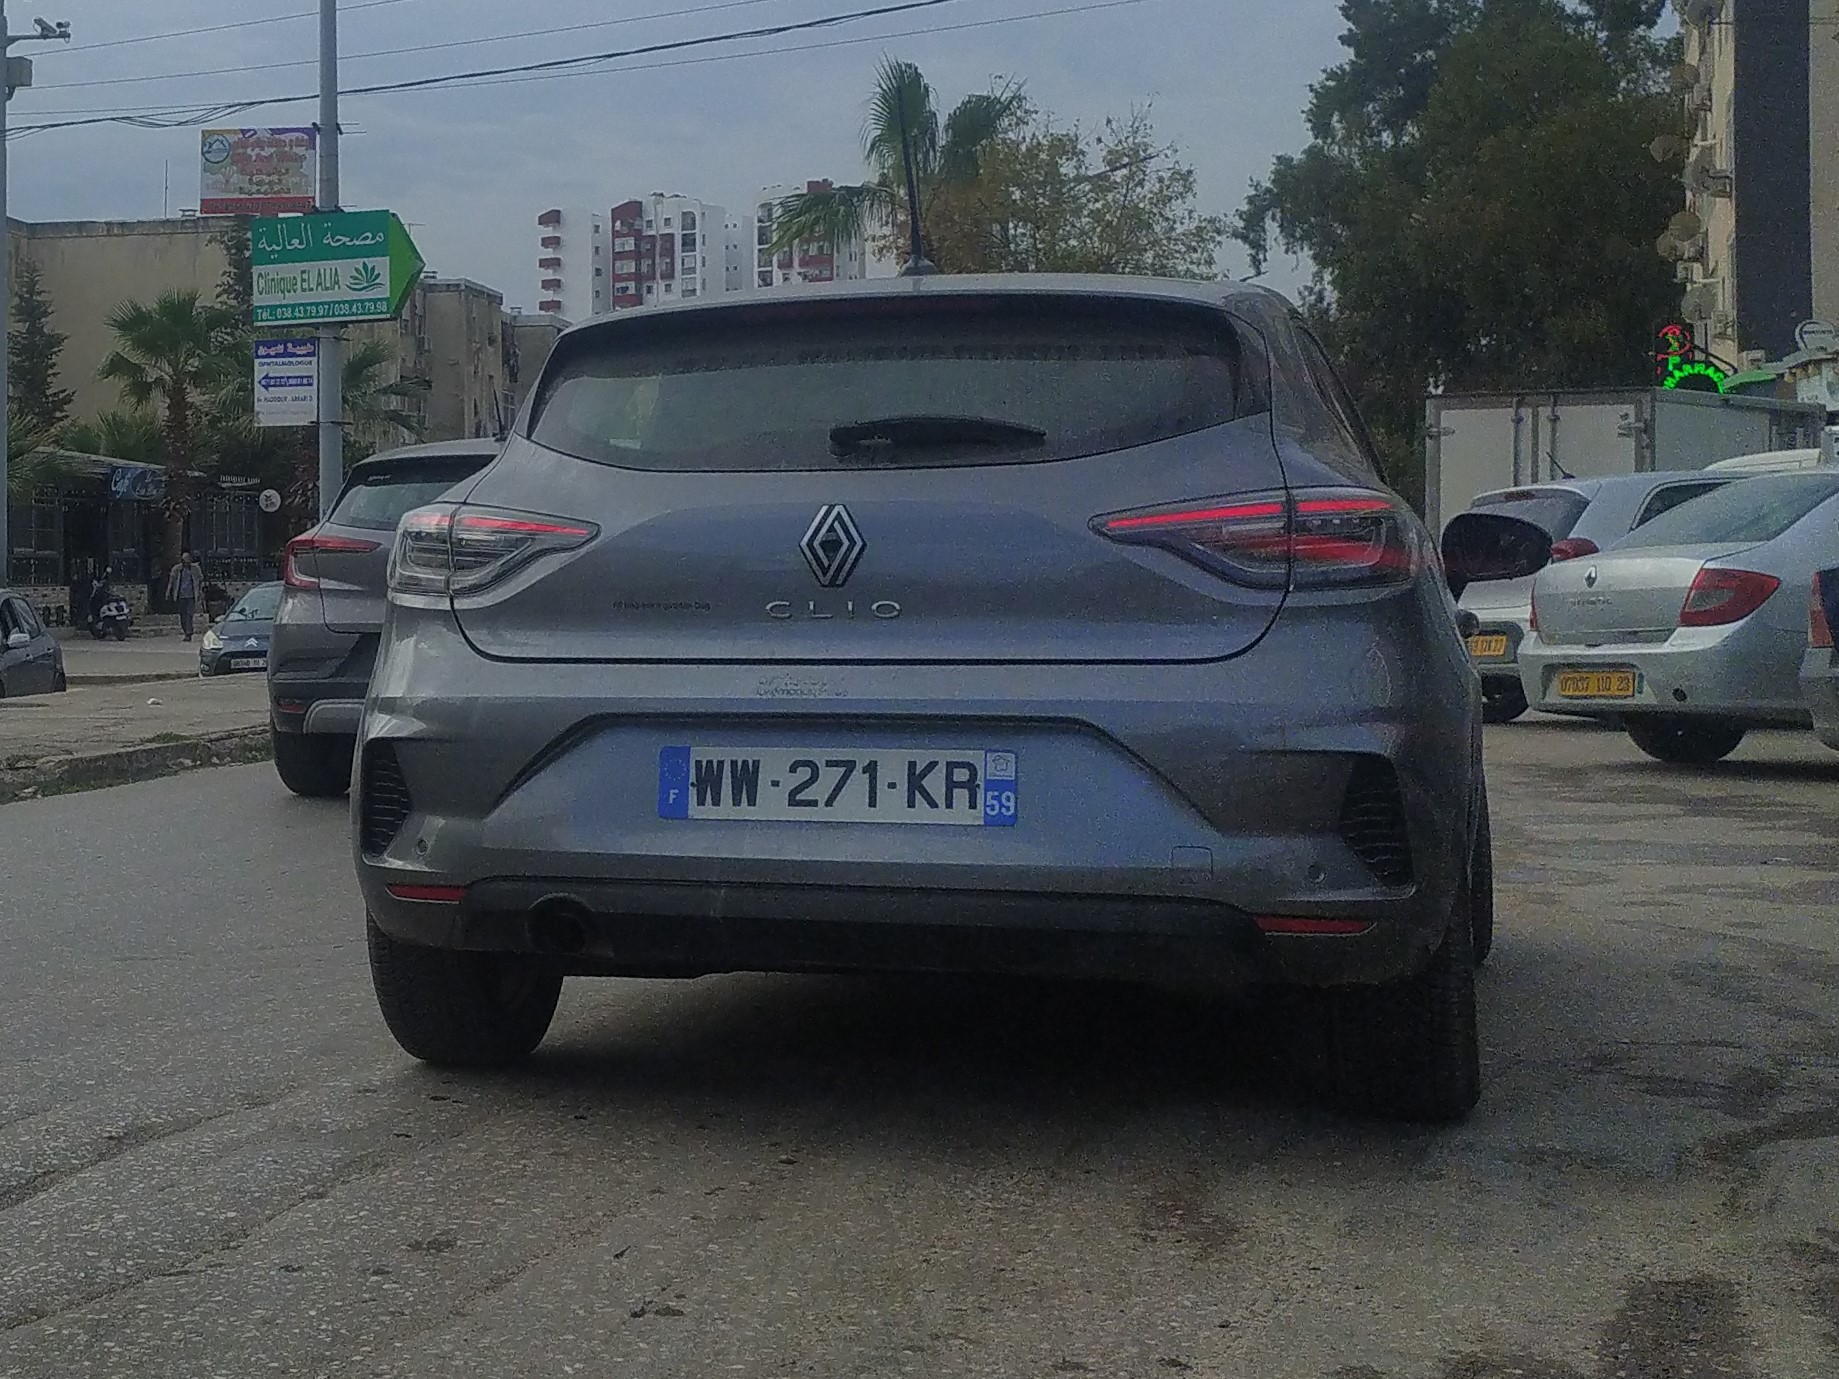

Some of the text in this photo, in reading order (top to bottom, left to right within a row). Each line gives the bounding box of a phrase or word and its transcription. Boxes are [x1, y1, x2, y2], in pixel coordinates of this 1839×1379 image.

[258, 222, 385, 260] مصحة العالية
[256, 267, 341, 300] Clinique EL ALIA
[765, 600, 902, 618] CLIO
[668, 789, 679, 804] F
[985, 790, 1016, 816] 59
